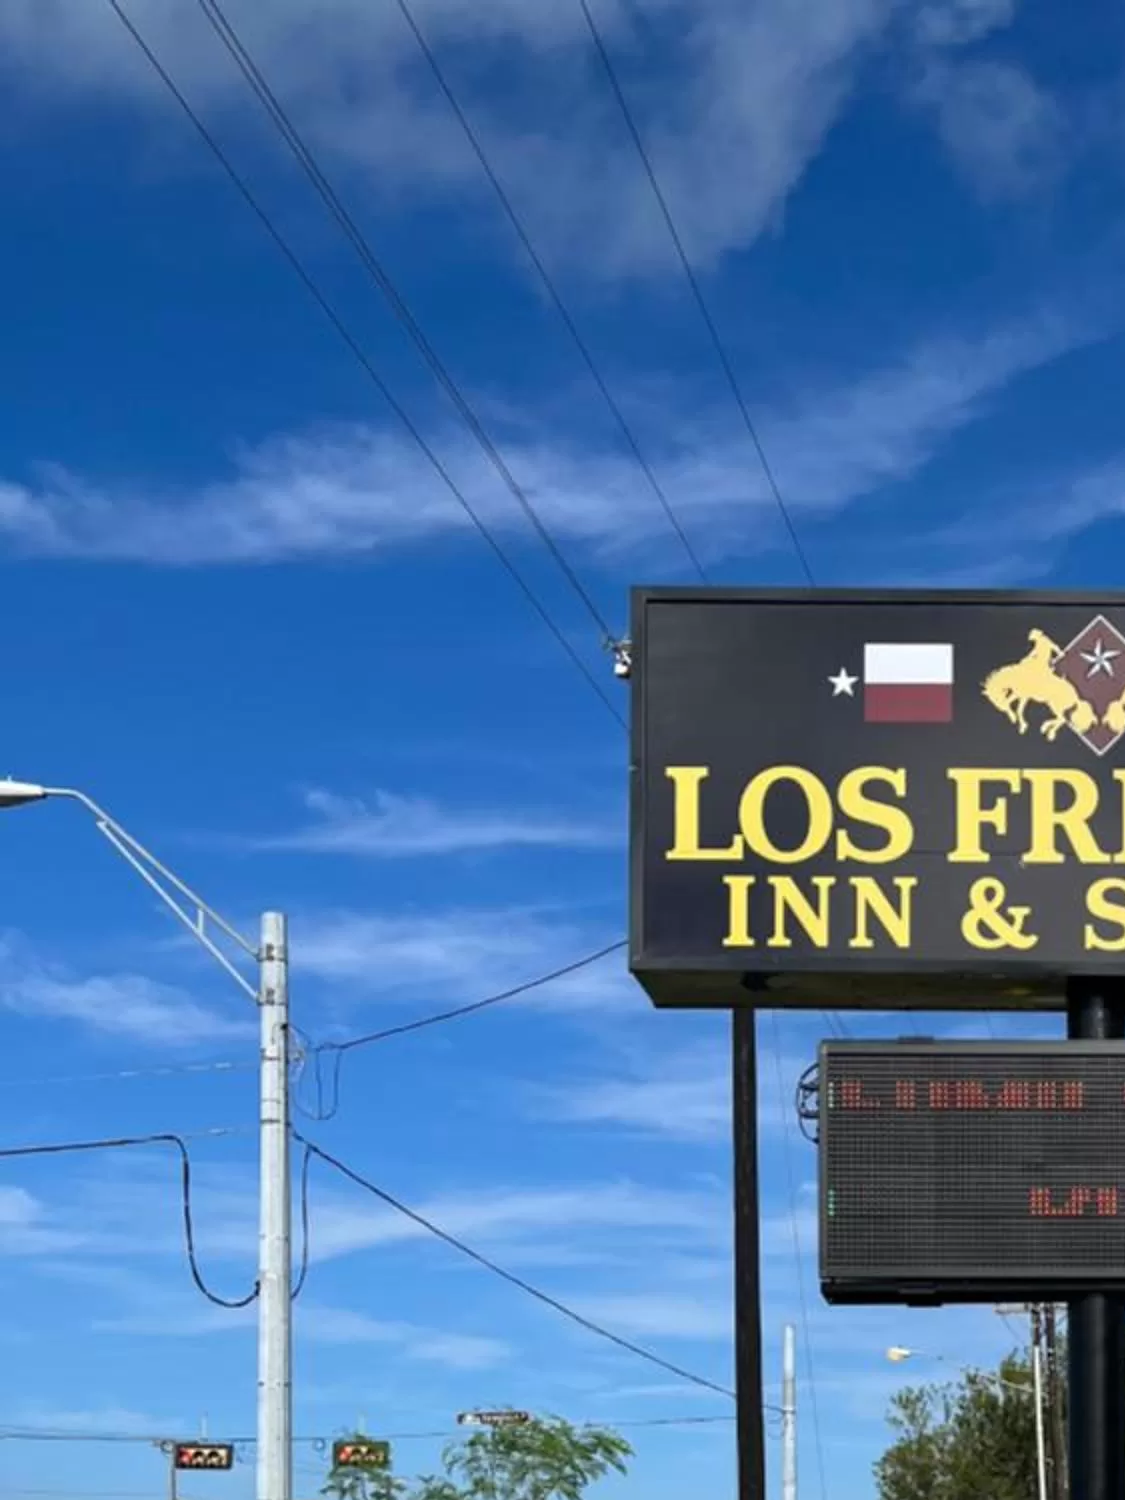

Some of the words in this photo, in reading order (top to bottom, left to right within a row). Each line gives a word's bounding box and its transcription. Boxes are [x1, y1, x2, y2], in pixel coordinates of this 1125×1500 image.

[665, 765, 914, 865] LOS
[723, 874, 916, 948] INN
[961, 877, 1038, 951] &
